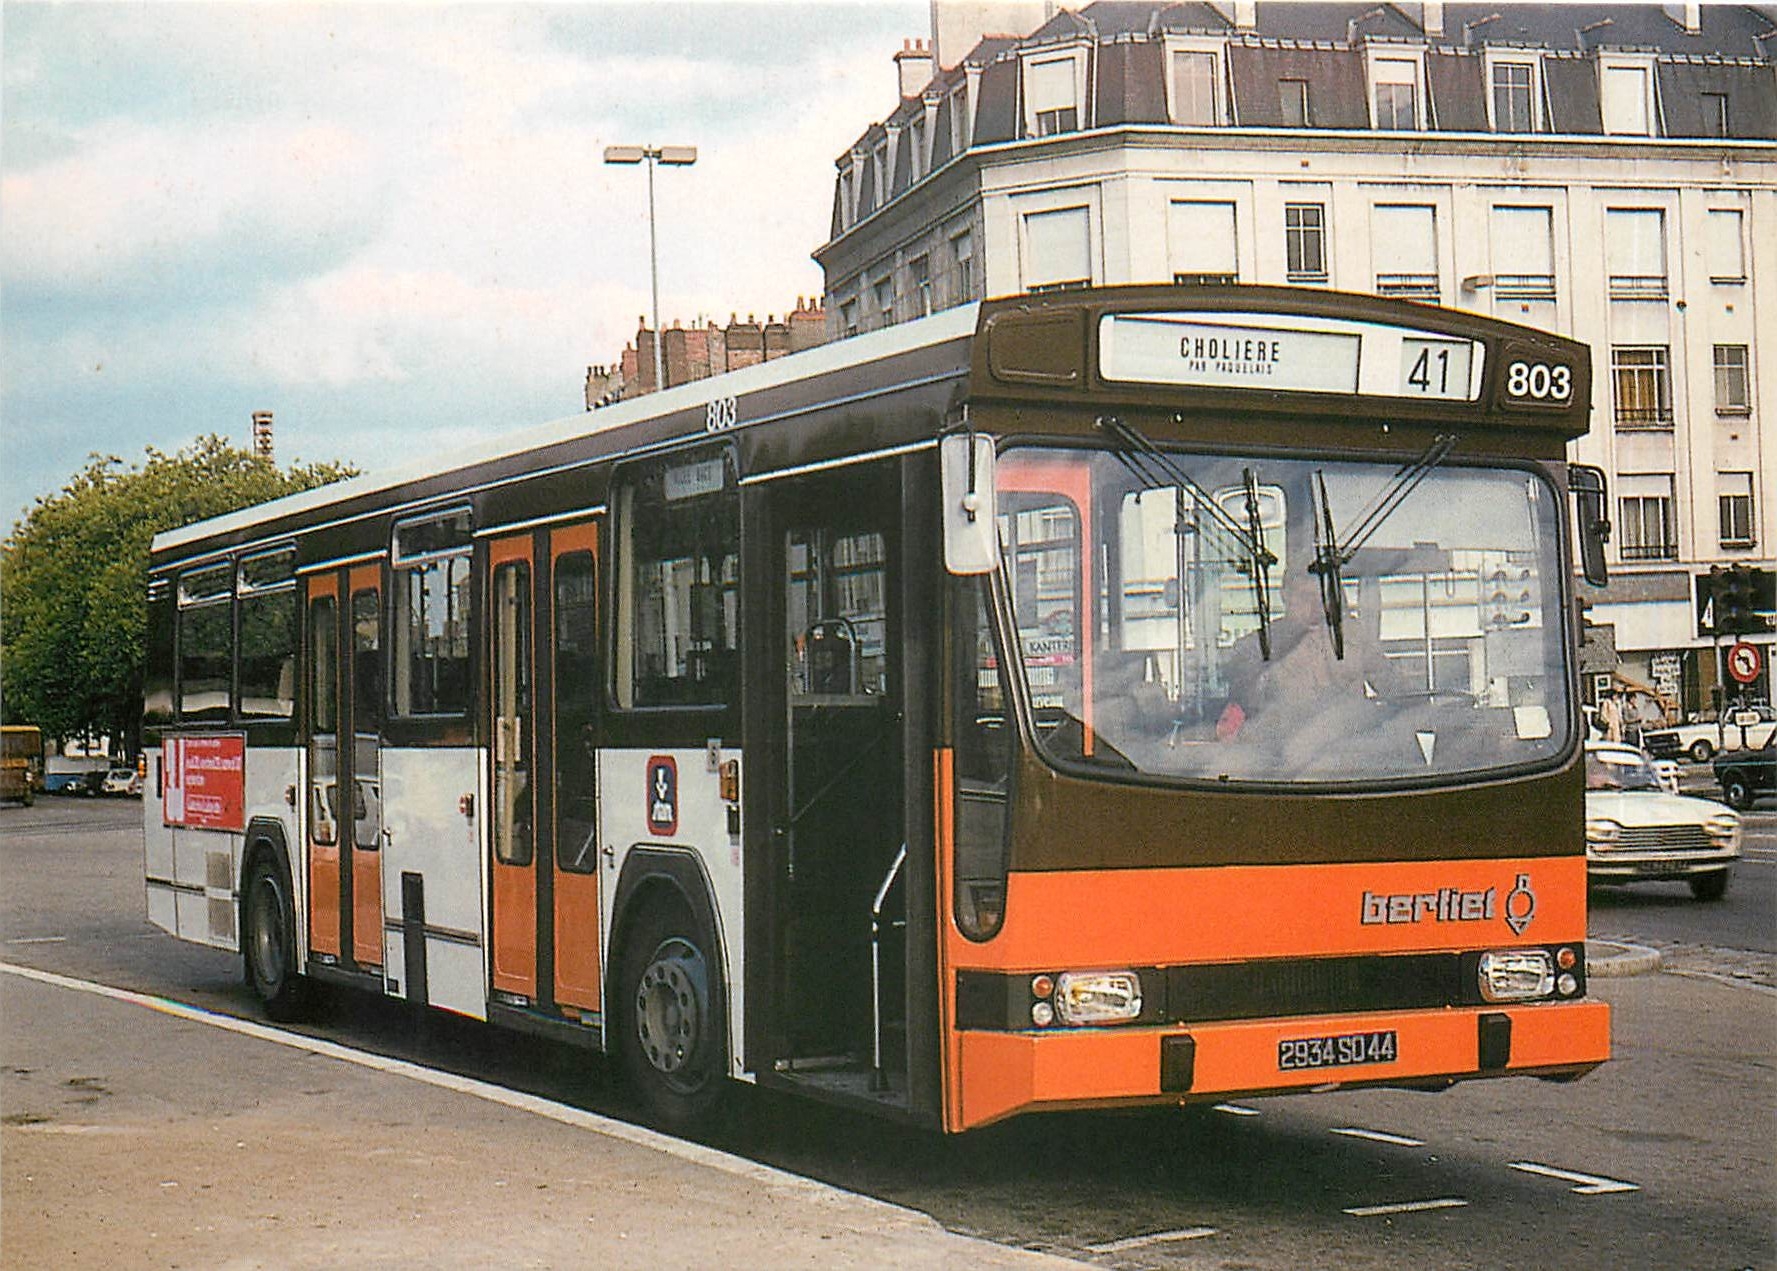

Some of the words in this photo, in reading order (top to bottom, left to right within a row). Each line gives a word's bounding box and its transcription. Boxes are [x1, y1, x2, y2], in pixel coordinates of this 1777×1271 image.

[1407, 347, 1449, 393] 41
[1507, 362, 1571, 400] 803
[706, 396, 737, 433] 803
[1361, 886, 1496, 925] berliet
[1280, 1037, 1335, 1069] 2934
[1368, 1033, 1395, 1060] 44
